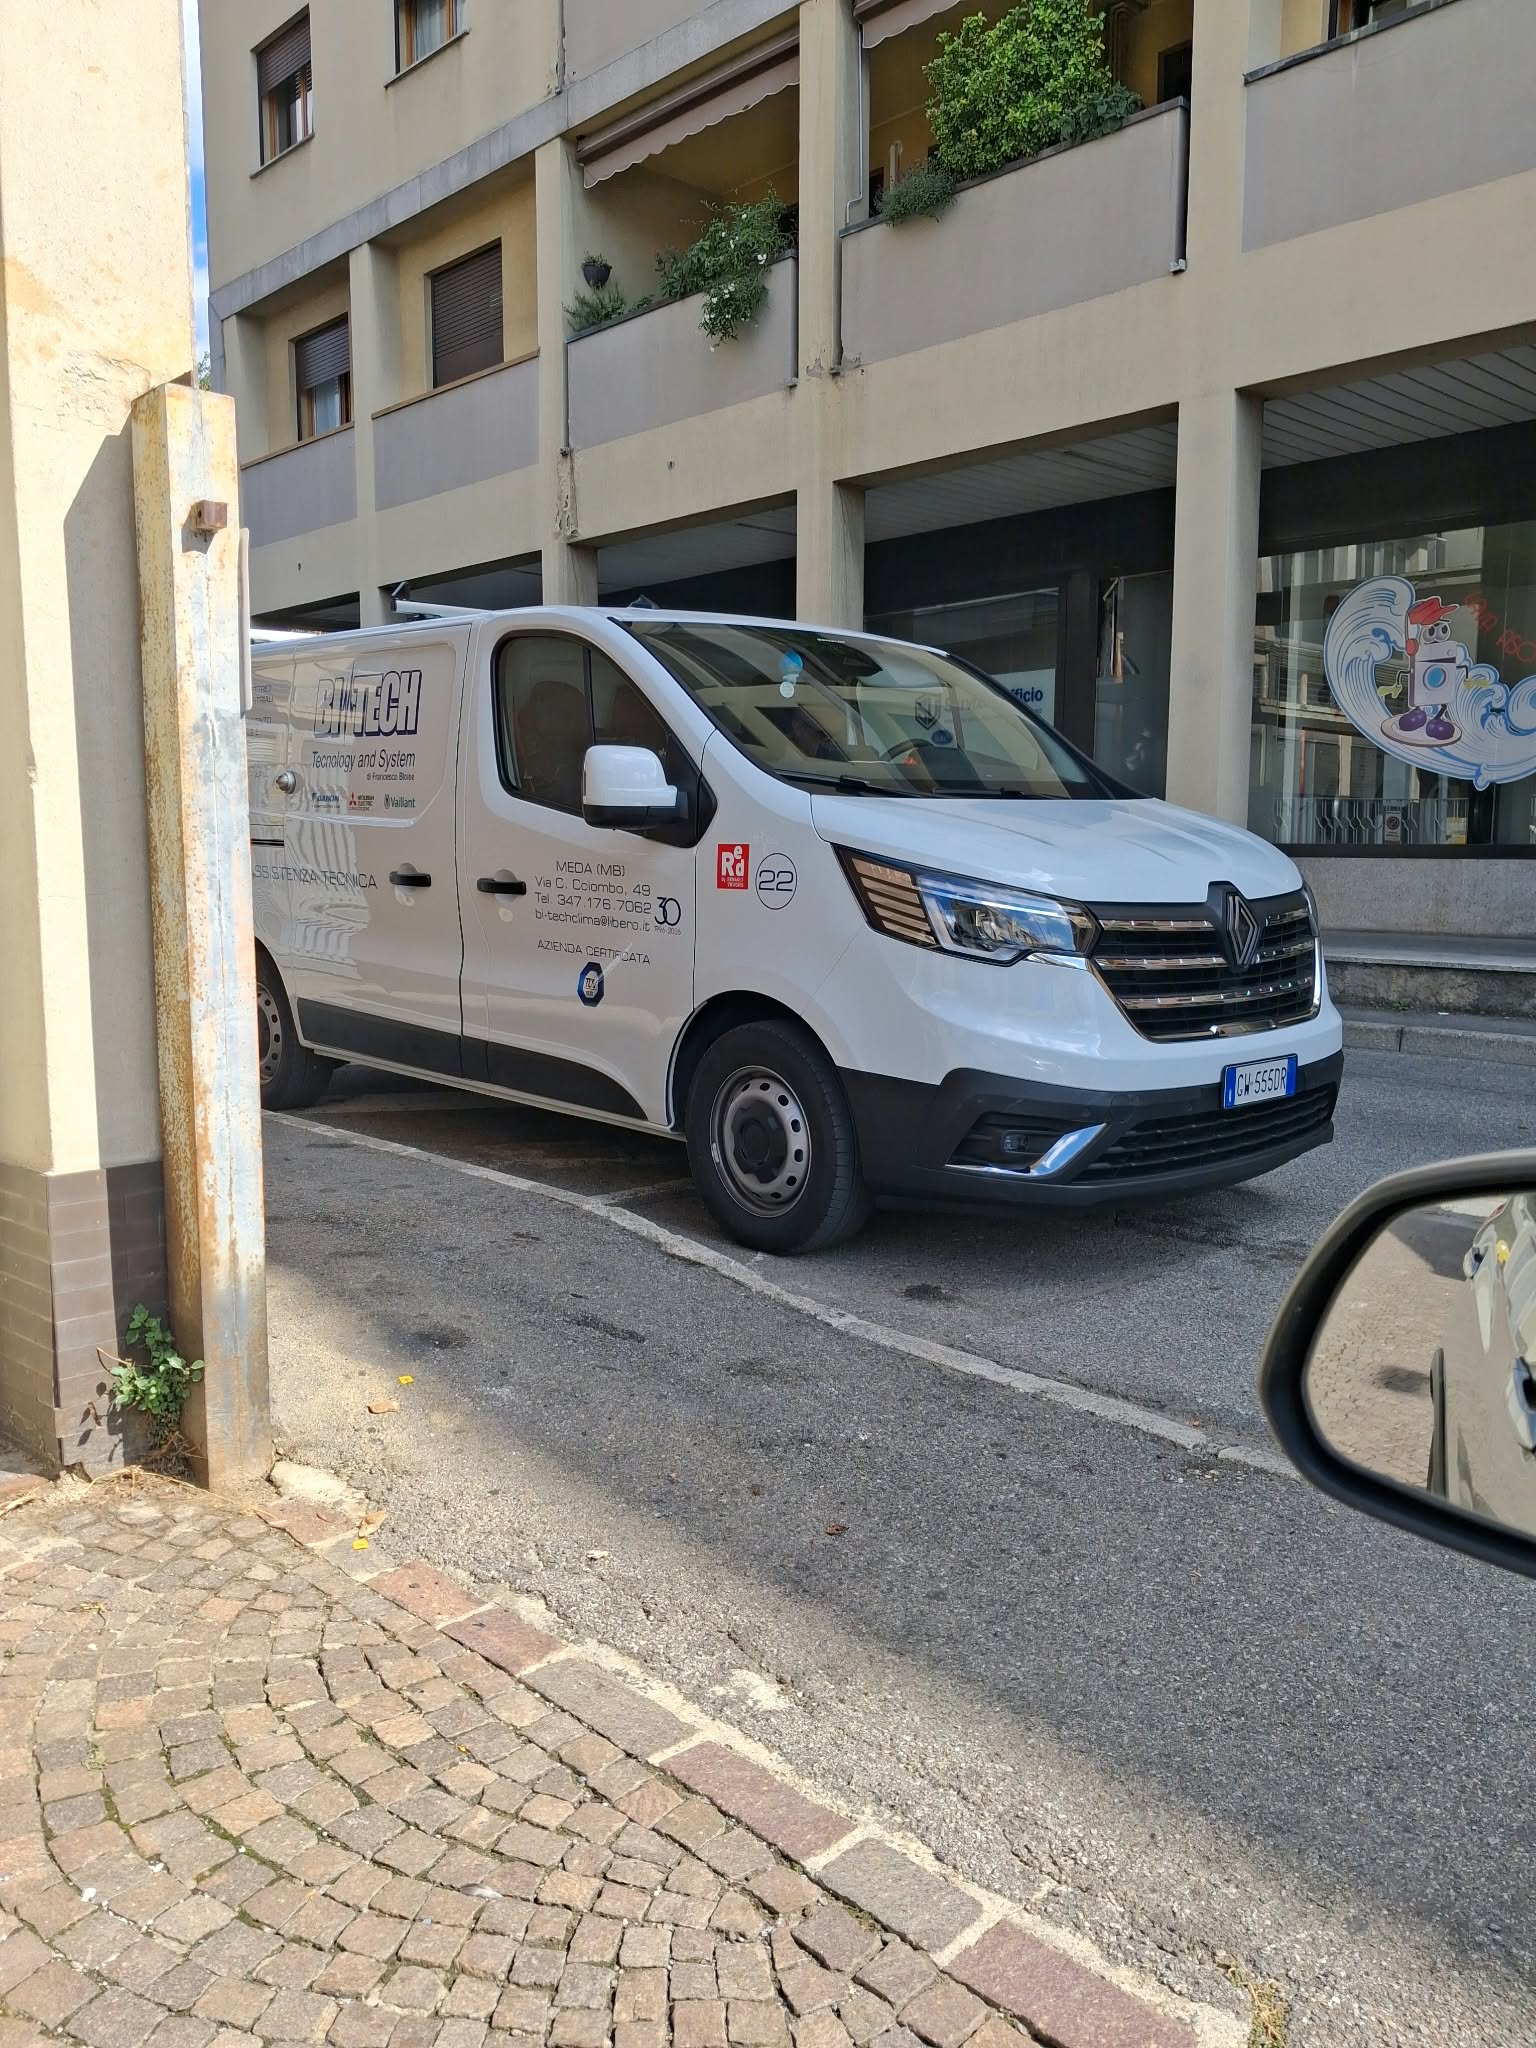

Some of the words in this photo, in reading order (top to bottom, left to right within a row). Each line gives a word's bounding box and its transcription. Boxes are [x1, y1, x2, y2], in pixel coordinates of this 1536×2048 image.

[312, 751, 355, 773] Tecnology
[357, 752, 376, 769] and
[378, 749, 416, 772] System
[372, 772, 398, 781] Francesco
[390, 796, 416, 808] Vaillant
[254, 864, 318, 883] SSISTENZA
[321, 870, 379, 890] TECNICA
[556, 860, 593, 875] MEDA
[596, 863, 626, 878] (MB)
[759, 869, 794, 892] 22
[534, 875, 551, 888] Via
[555, 877, 567, 890] C.
[572, 878, 628, 896] Colombo,
[632, 883, 651, 897] 49
[534, 891, 553, 904] Tel.
[557, 894, 652, 915] 347.176.7062
[535, 908, 650, 932] bi-techclima@libero.it
[537, 939, 583, 955] AZIENDA
[586, 945, 651, 966] CERTIFICATA
